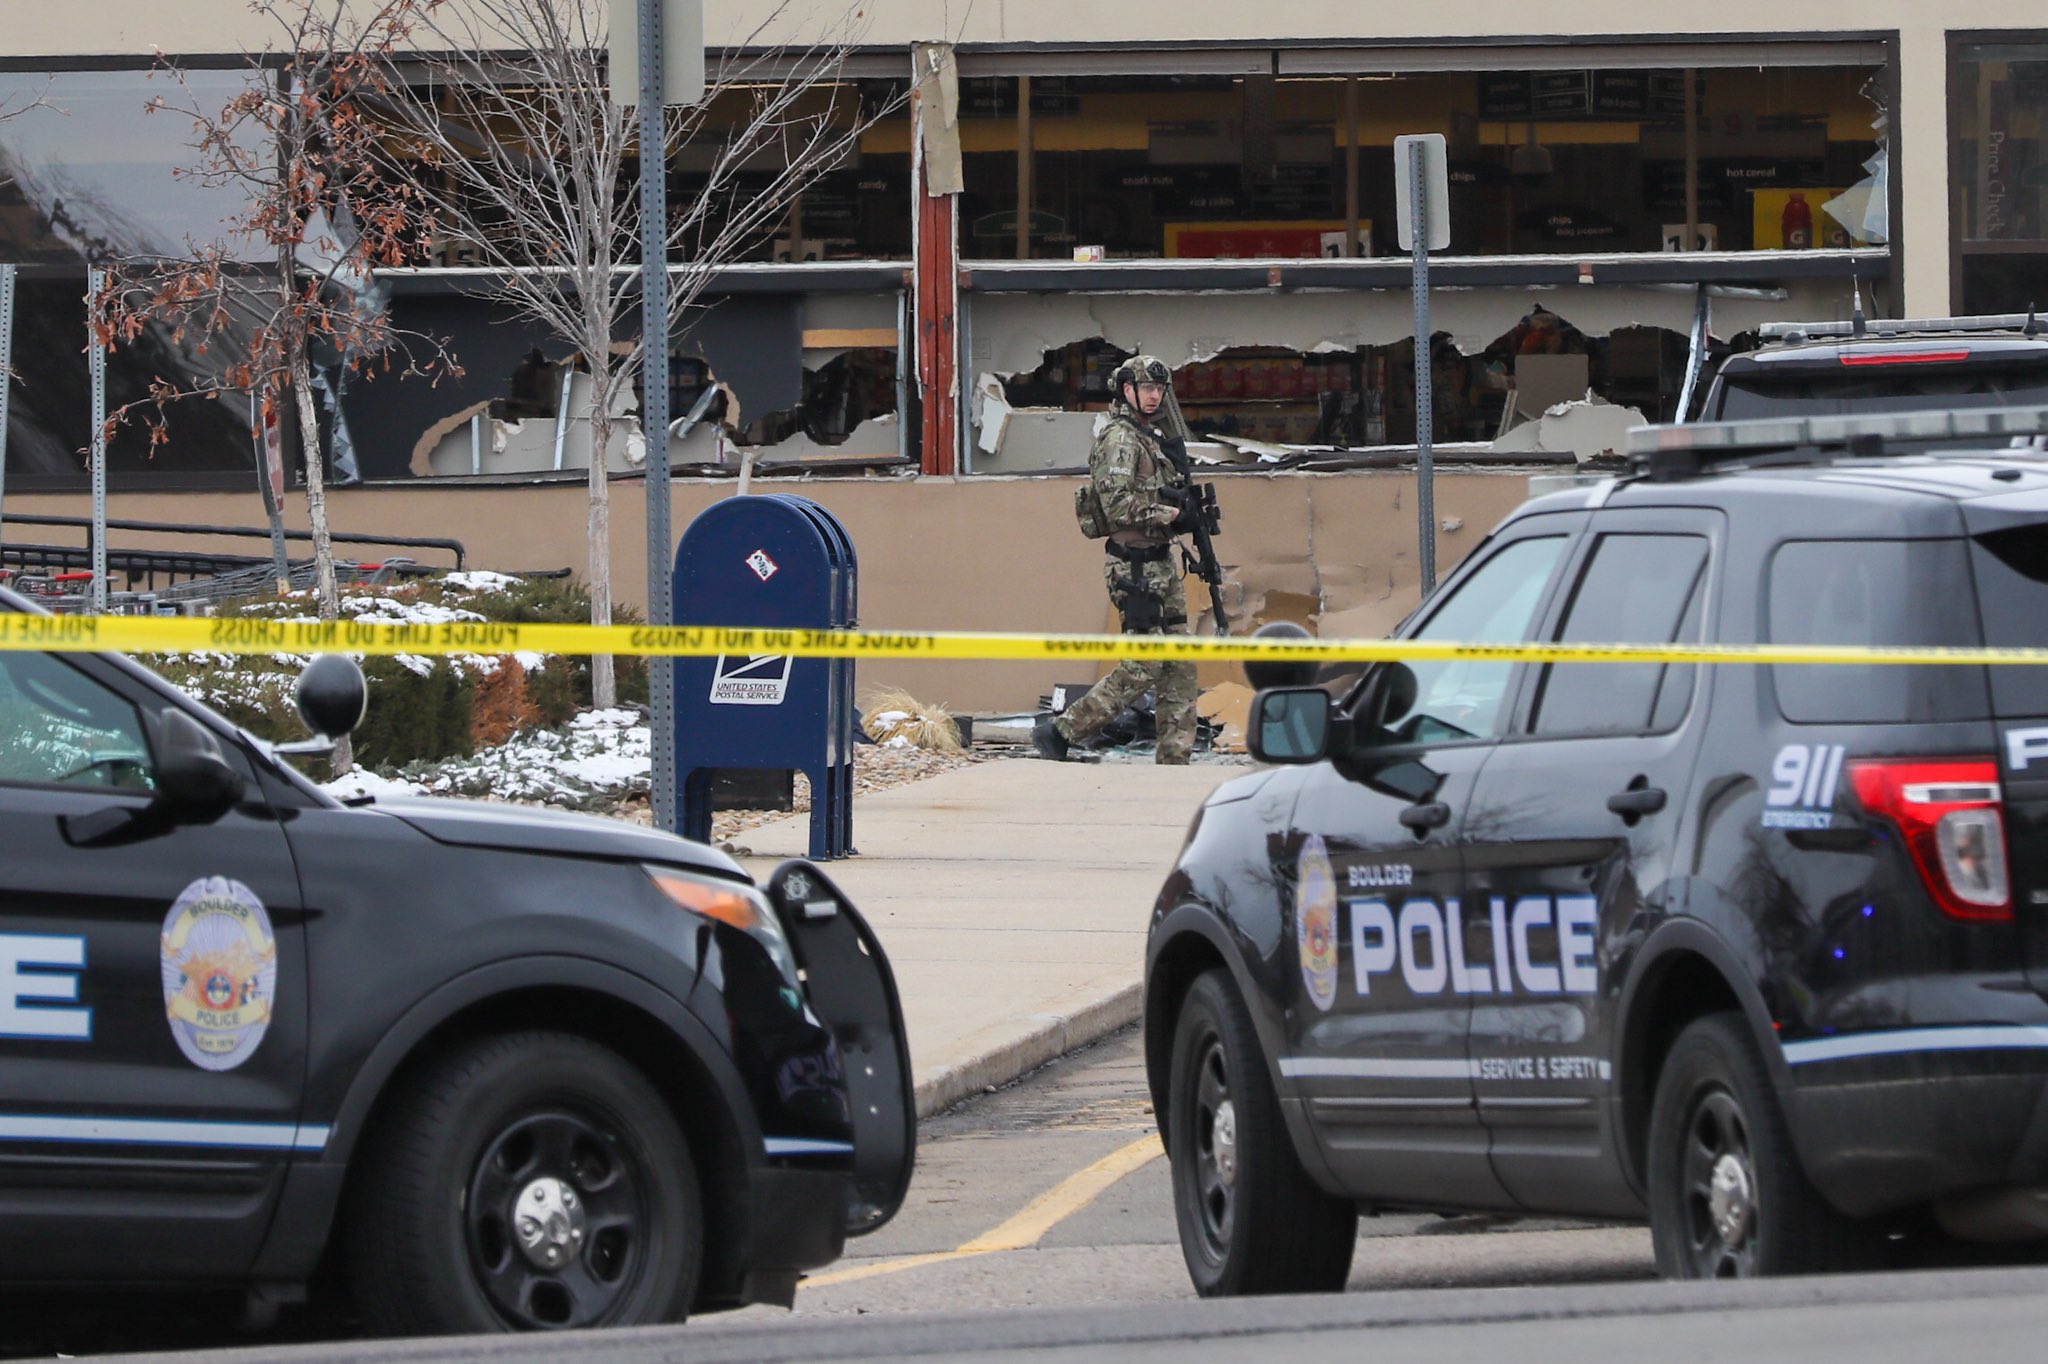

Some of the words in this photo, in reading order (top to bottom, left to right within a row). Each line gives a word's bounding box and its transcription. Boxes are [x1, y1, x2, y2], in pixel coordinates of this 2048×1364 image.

[1988, 131, 2005, 174] Price
[1450, 170, 1476, 183] chips
[1726, 167, 1745, 177] hot
[1746, 167, 1776, 177] cereal
[857, 180, 888, 192] candy
[1987, 180, 2006, 232] Check
[1547, 215, 1573, 225] chips
[1789, 230, 1805, 245] G
[1109, 465, 1131, 476] POLICE
[717, 683, 749, 691] UNITED
[749, 683, 777, 691] STATES
[715, 691, 745, 699] POSTAL
[746, 692, 779, 700] SERVICE
[1766, 744, 1846, 808] 911
[1348, 864, 1412, 887] BOULDER
[190, 897, 249, 920] BOULDER
[1349, 893, 1598, 997] POLICE
[196, 1010, 241, 1027] POLICE
[1480, 1057, 1535, 1079] SERVICE
[1550, 1057, 1599, 1079] SAFETY
